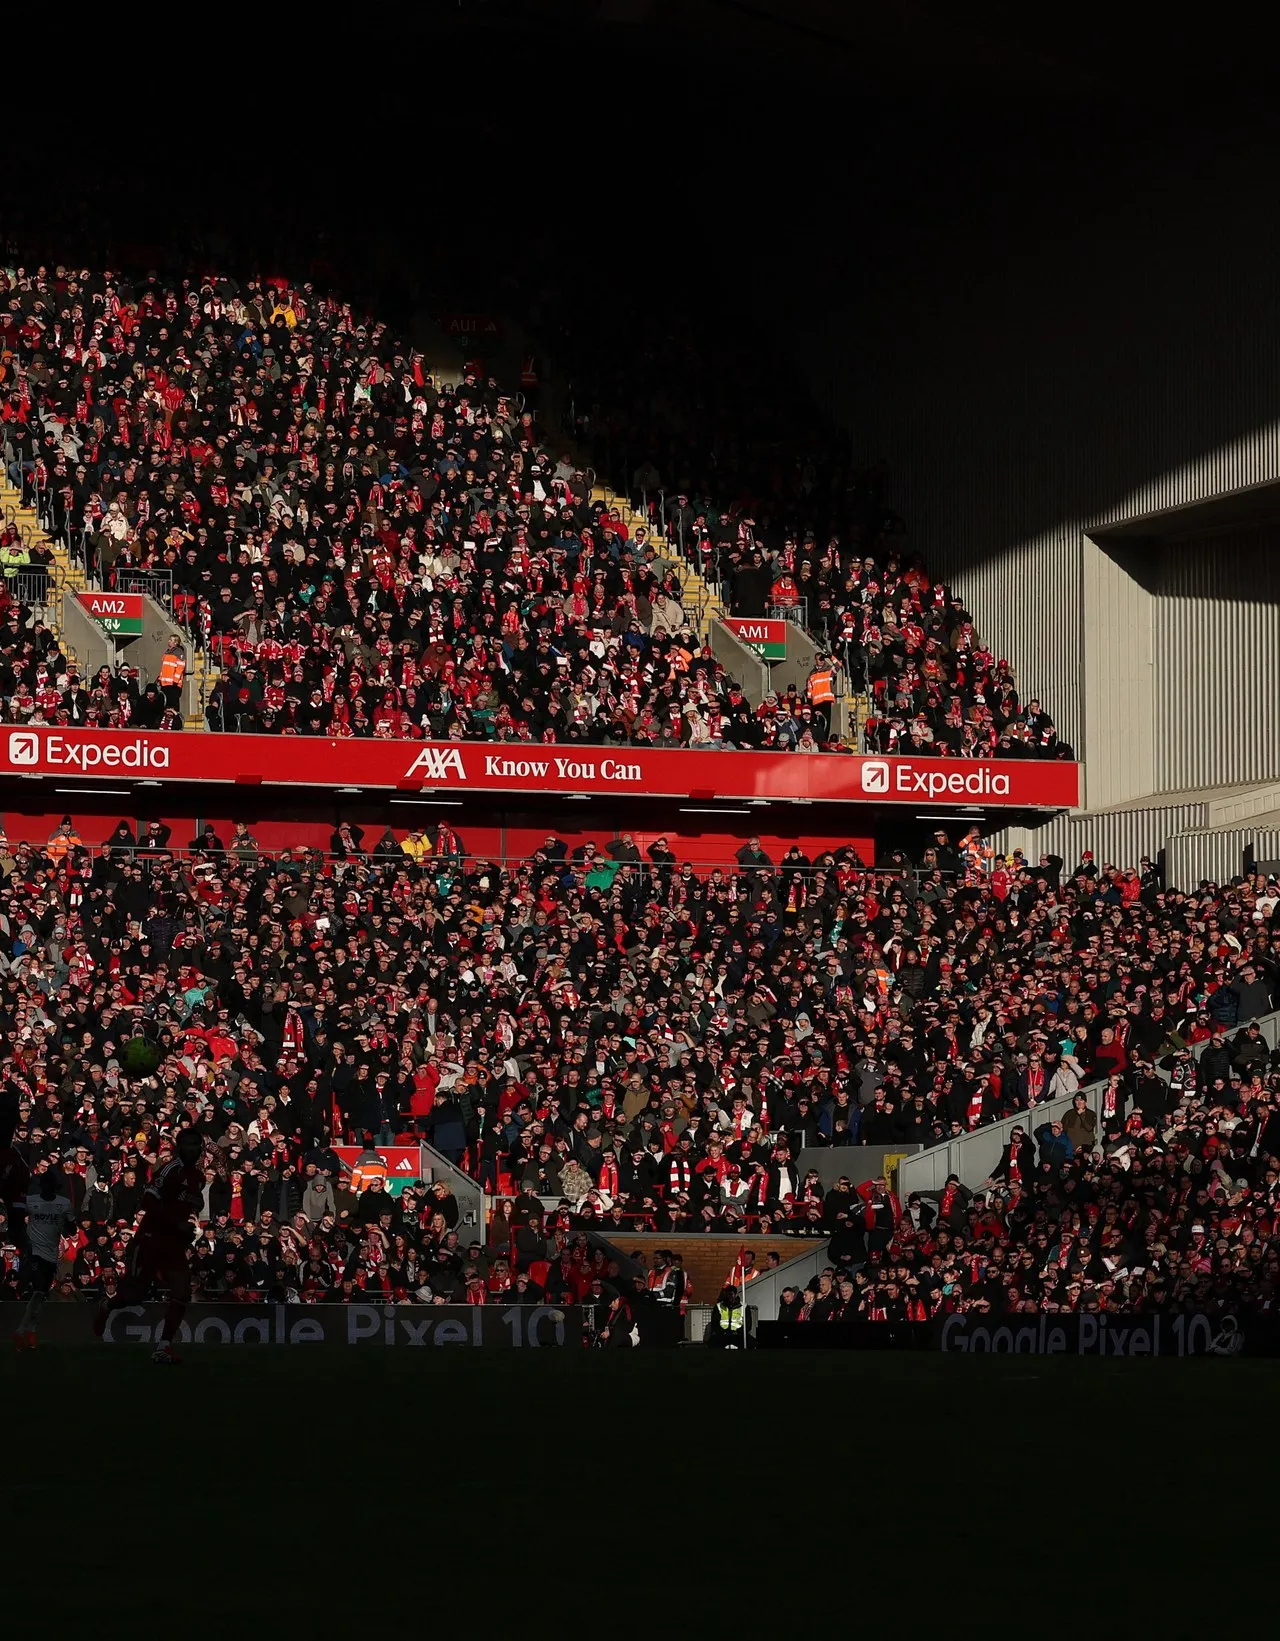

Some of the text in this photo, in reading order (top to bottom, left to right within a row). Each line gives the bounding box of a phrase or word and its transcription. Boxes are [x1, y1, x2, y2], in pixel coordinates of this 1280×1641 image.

[449, 319, 476, 331] AU1
[91, 600, 126, 614] AM2
[737, 625, 769, 639] AM1
[46, 736, 169, 770] Expedia
[404, 748, 467, 779] AXA
[485, 755, 642, 780] Know You Can
[896, 765, 1010, 798] Expedia
[347, 1305, 483, 1347] Pixel
[502, 1306, 566, 1347] 10
[941, 1313, 1213, 1357] Google Pixel 10
